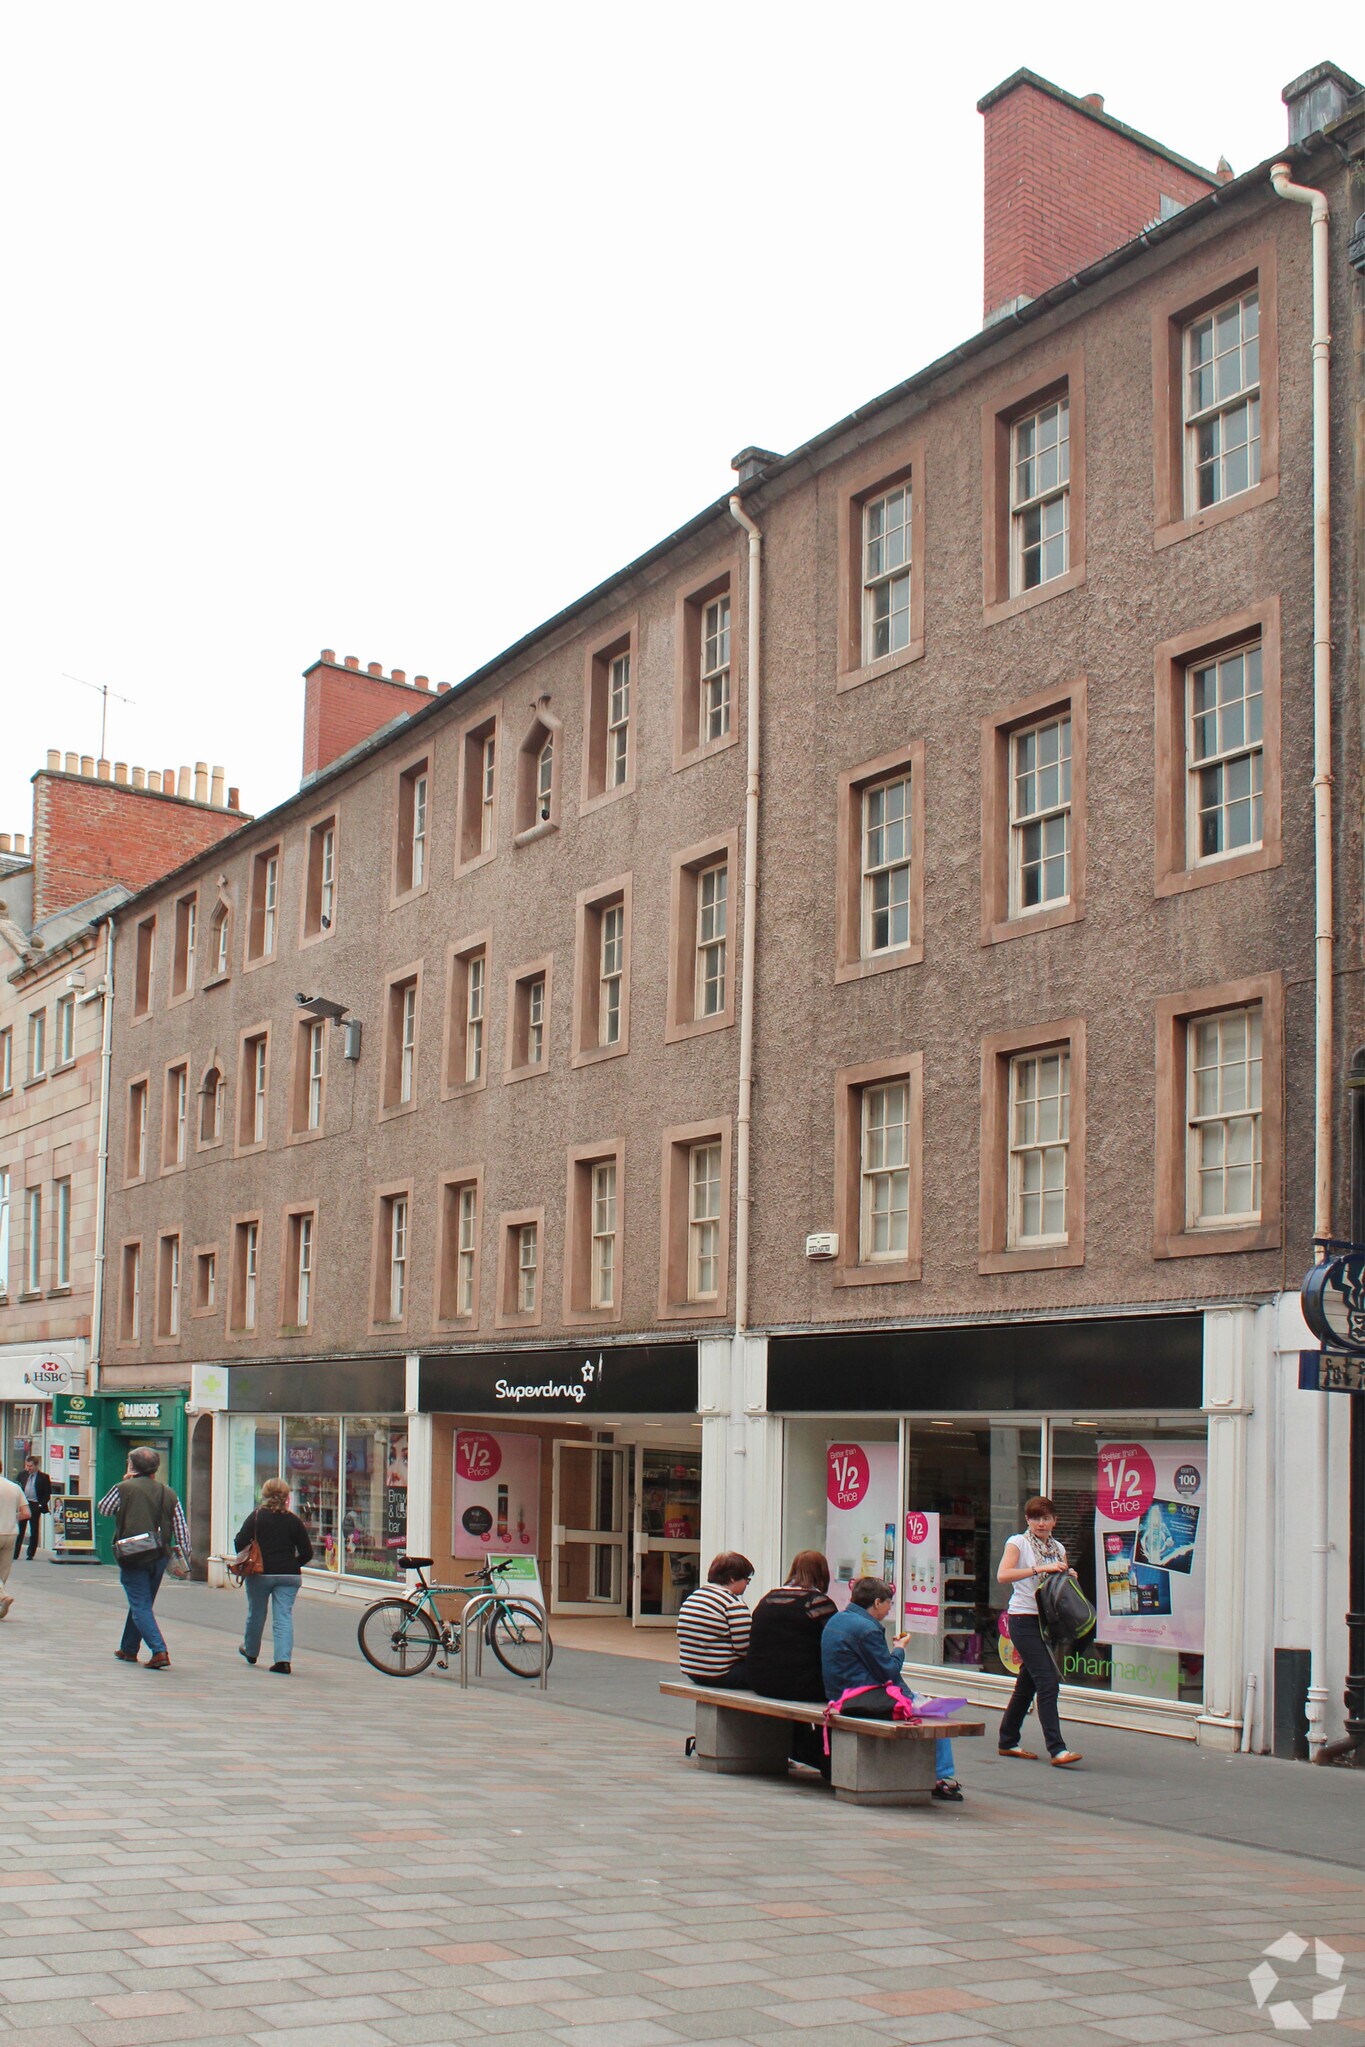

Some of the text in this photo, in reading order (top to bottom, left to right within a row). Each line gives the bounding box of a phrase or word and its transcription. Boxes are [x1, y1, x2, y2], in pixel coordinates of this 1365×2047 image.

[34, 1372, 67, 1382] HSBC
[495, 1380, 586, 1403] Superdrug
[124, 1403, 159, 1418] RAMSDENS
[460, 1442, 491, 1467] 1/2
[830, 1448, 857, 1459] Better than
[1101, 1448, 1138, 1462] Better than
[467, 1467, 490, 1476] Price
[832, 1457, 859, 1491] 1/2
[1103, 1459, 1143, 1500] 1/2
[1179, 1475, 1196, 1485] 100
[837, 1491, 858, 1503] Price
[388, 1505, 394, 1517] &
[1110, 1500, 1140, 1514] Price
[388, 1520, 400, 1532] bar
[908, 1518, 923, 1535] 1/2
[1063, 1652, 1159, 1689] pharmacy
